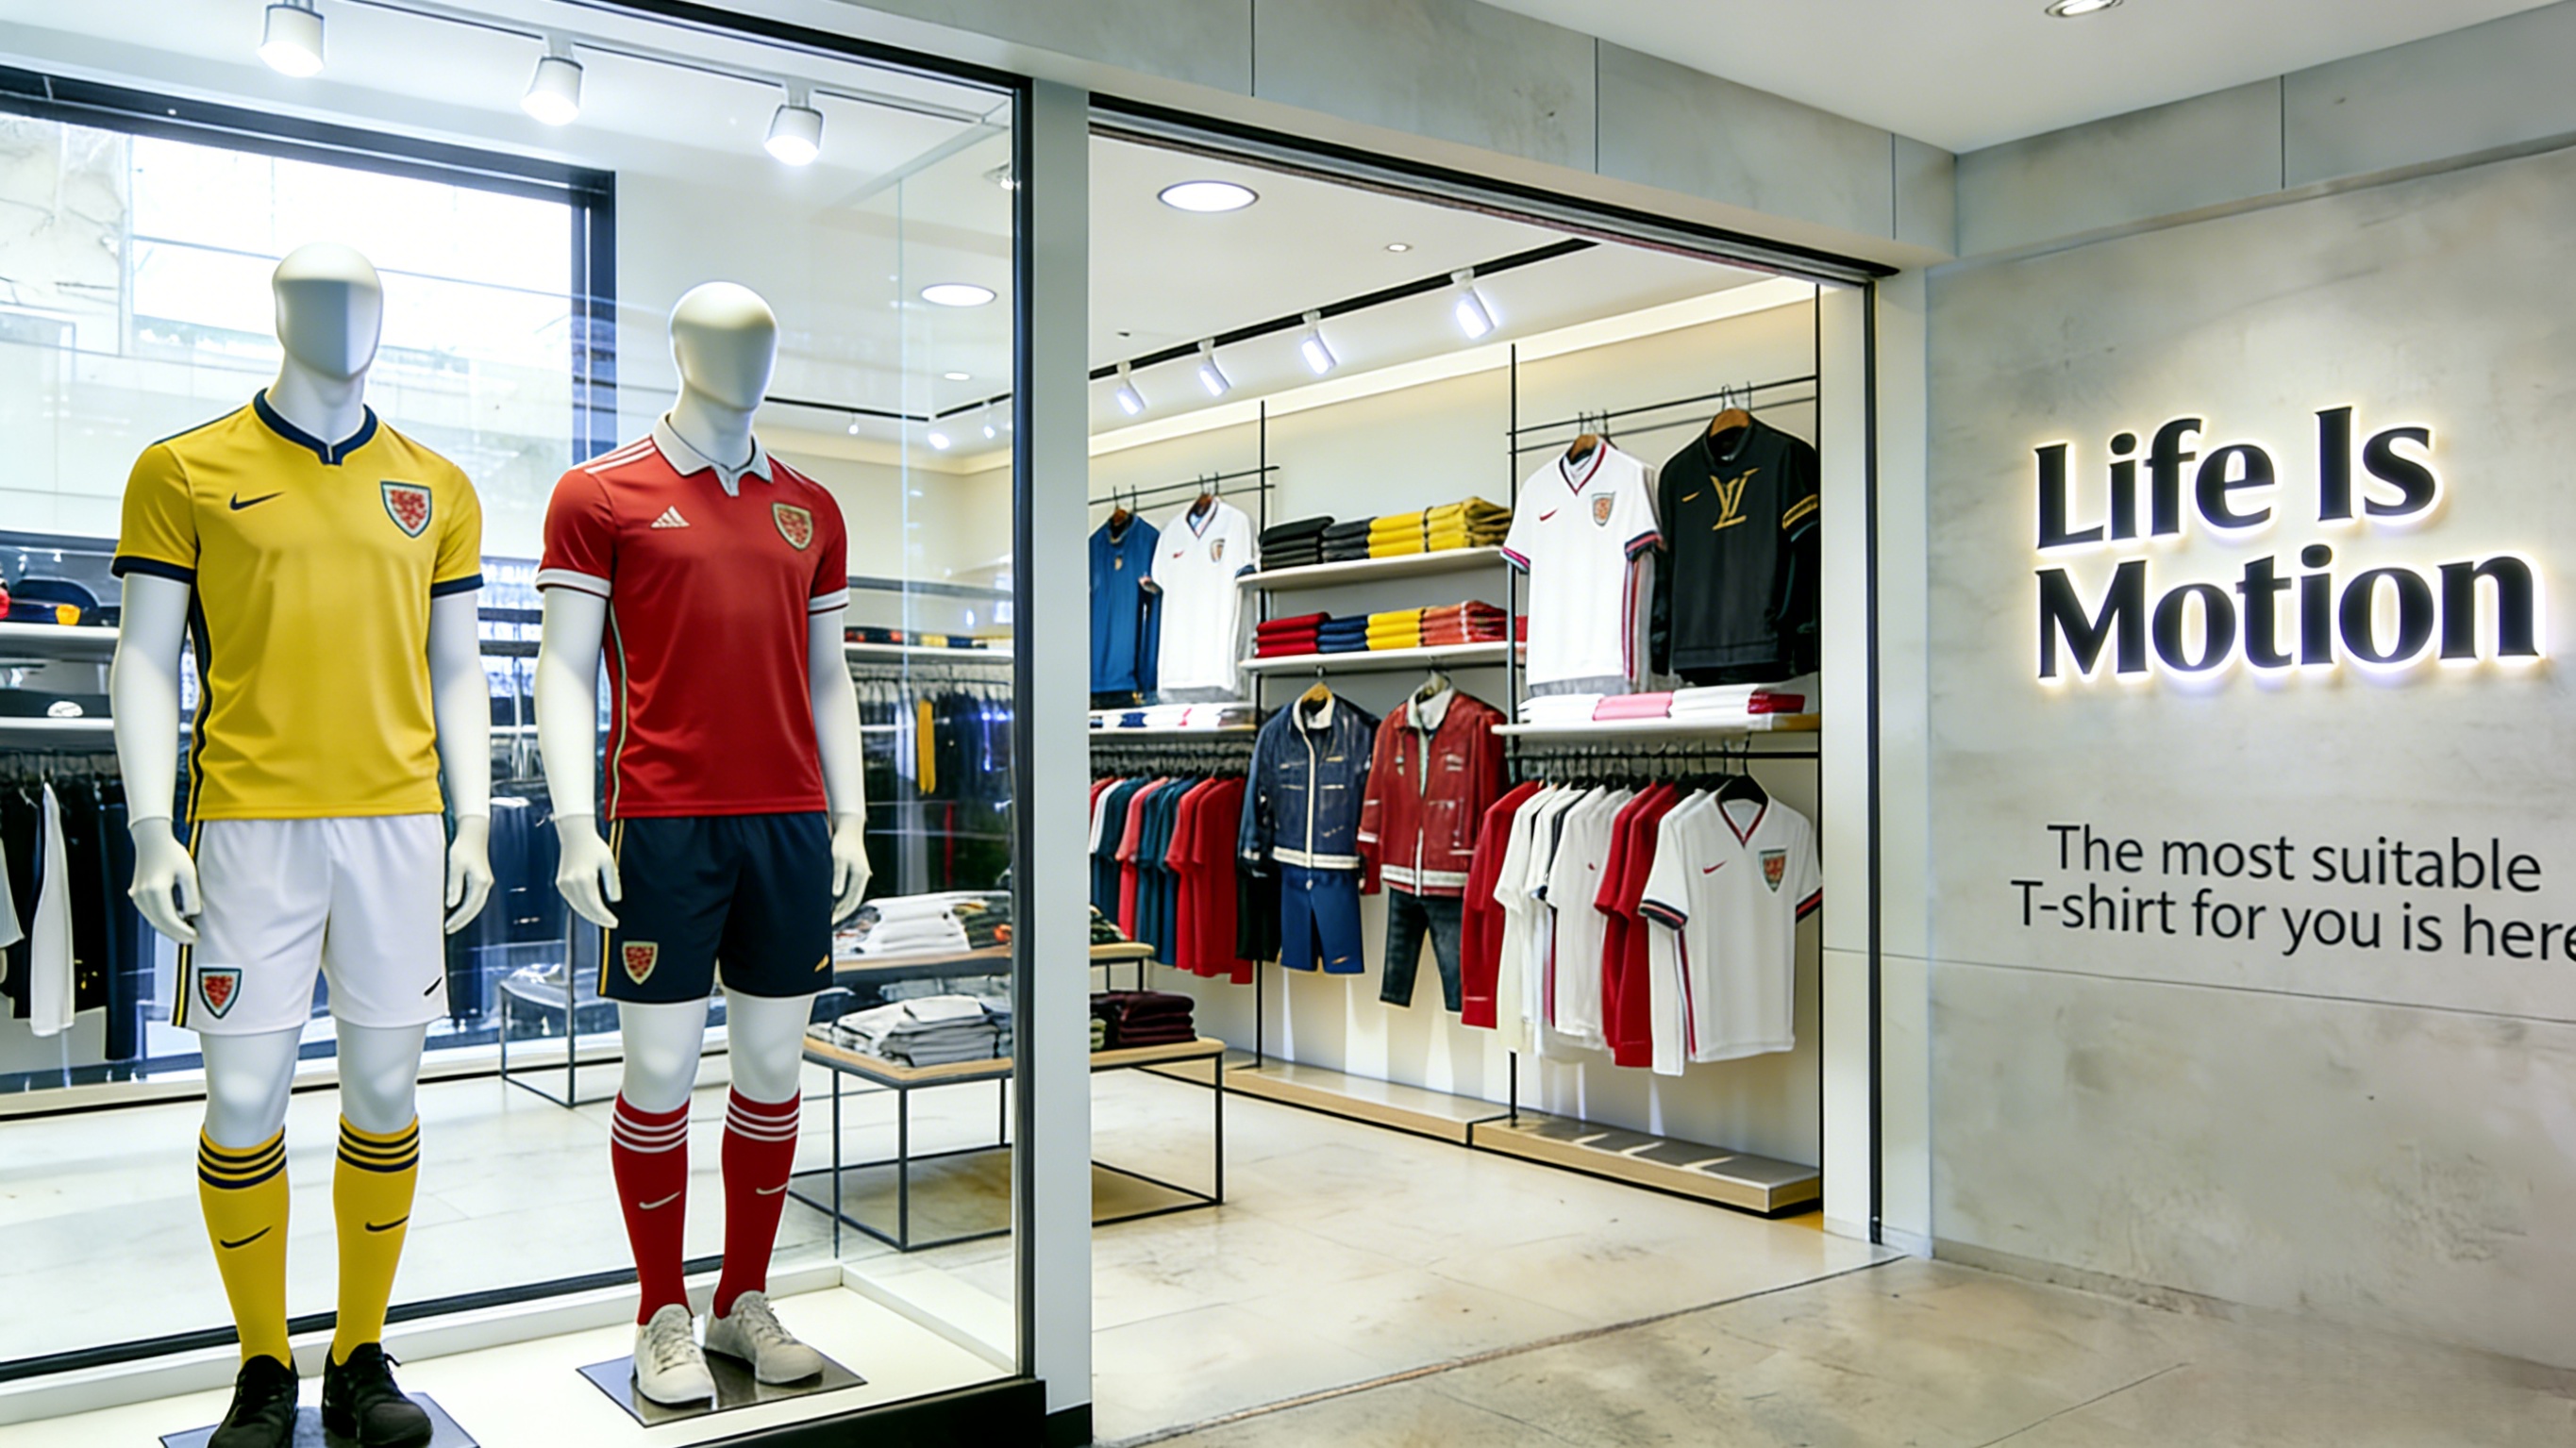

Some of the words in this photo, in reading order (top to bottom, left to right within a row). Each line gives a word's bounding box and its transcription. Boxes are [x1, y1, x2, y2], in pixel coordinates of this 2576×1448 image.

[2034, 417, 2275, 549] Life
[2315, 406, 2436, 521] Is
[2034, 543, 2539, 678] Motion
[2047, 824, 2144, 874] The
[2162, 835, 2295, 880] most
[2312, 836, 2541, 892] suitable
[2010, 879, 2177, 935] T-shirt
[2191, 888, 2267, 940] for
[2282, 907, 2381, 957] you
[2401, 902, 2444, 953] is
